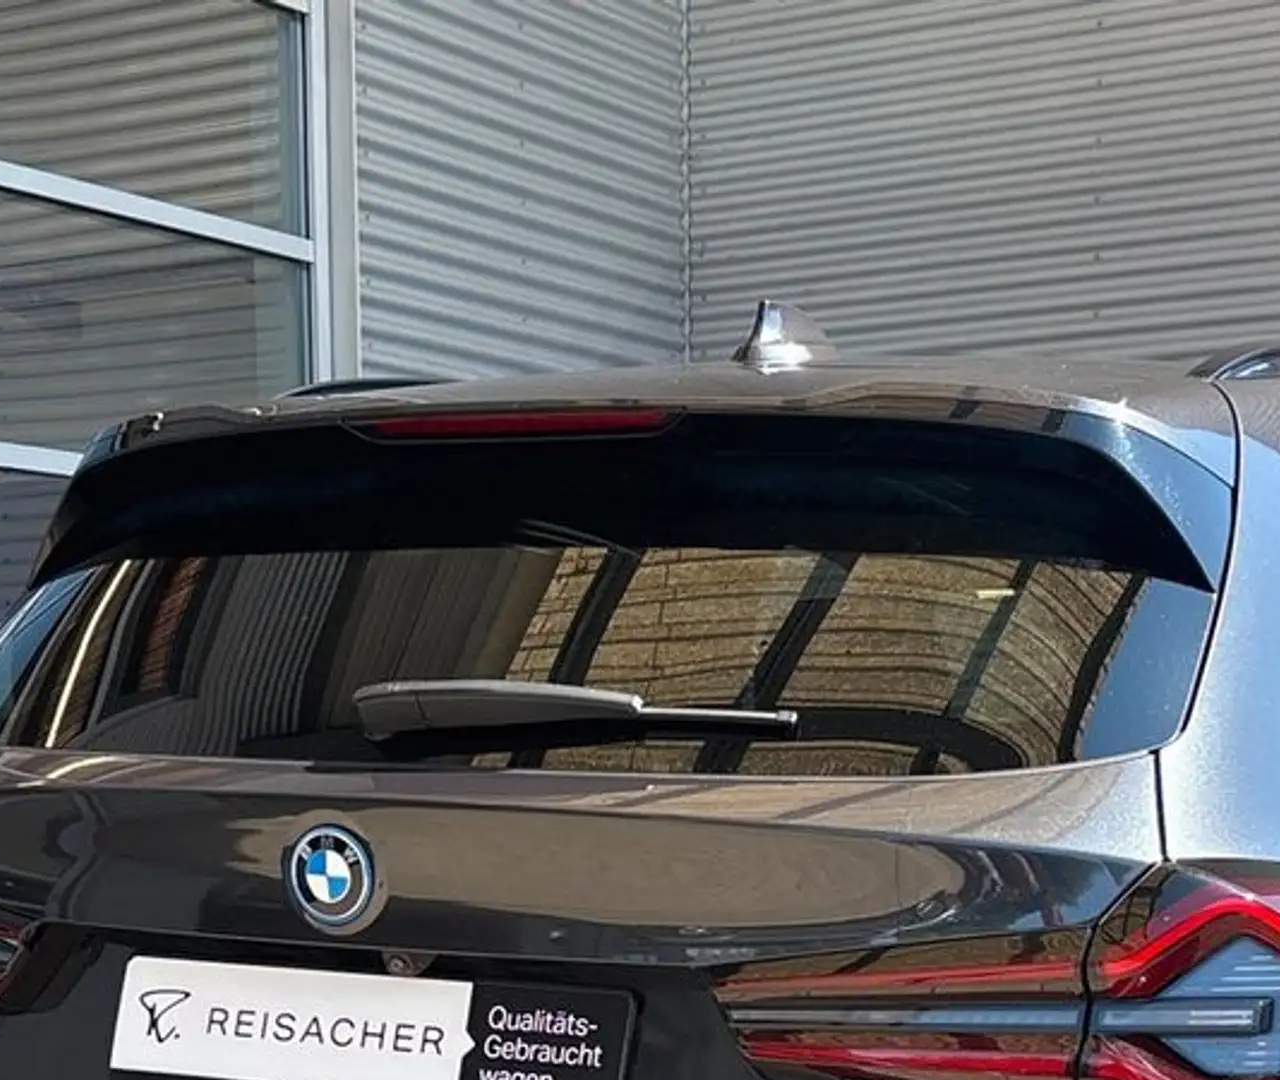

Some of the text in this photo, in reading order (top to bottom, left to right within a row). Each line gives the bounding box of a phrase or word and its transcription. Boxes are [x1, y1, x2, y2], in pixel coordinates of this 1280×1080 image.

[300, 836, 359, 863] BMW
[206, 1007, 446, 1056] REISACHER
[487, 1004, 598, 1037] Qualitäts-
[483, 1034, 604, 1068] Gebraucht
